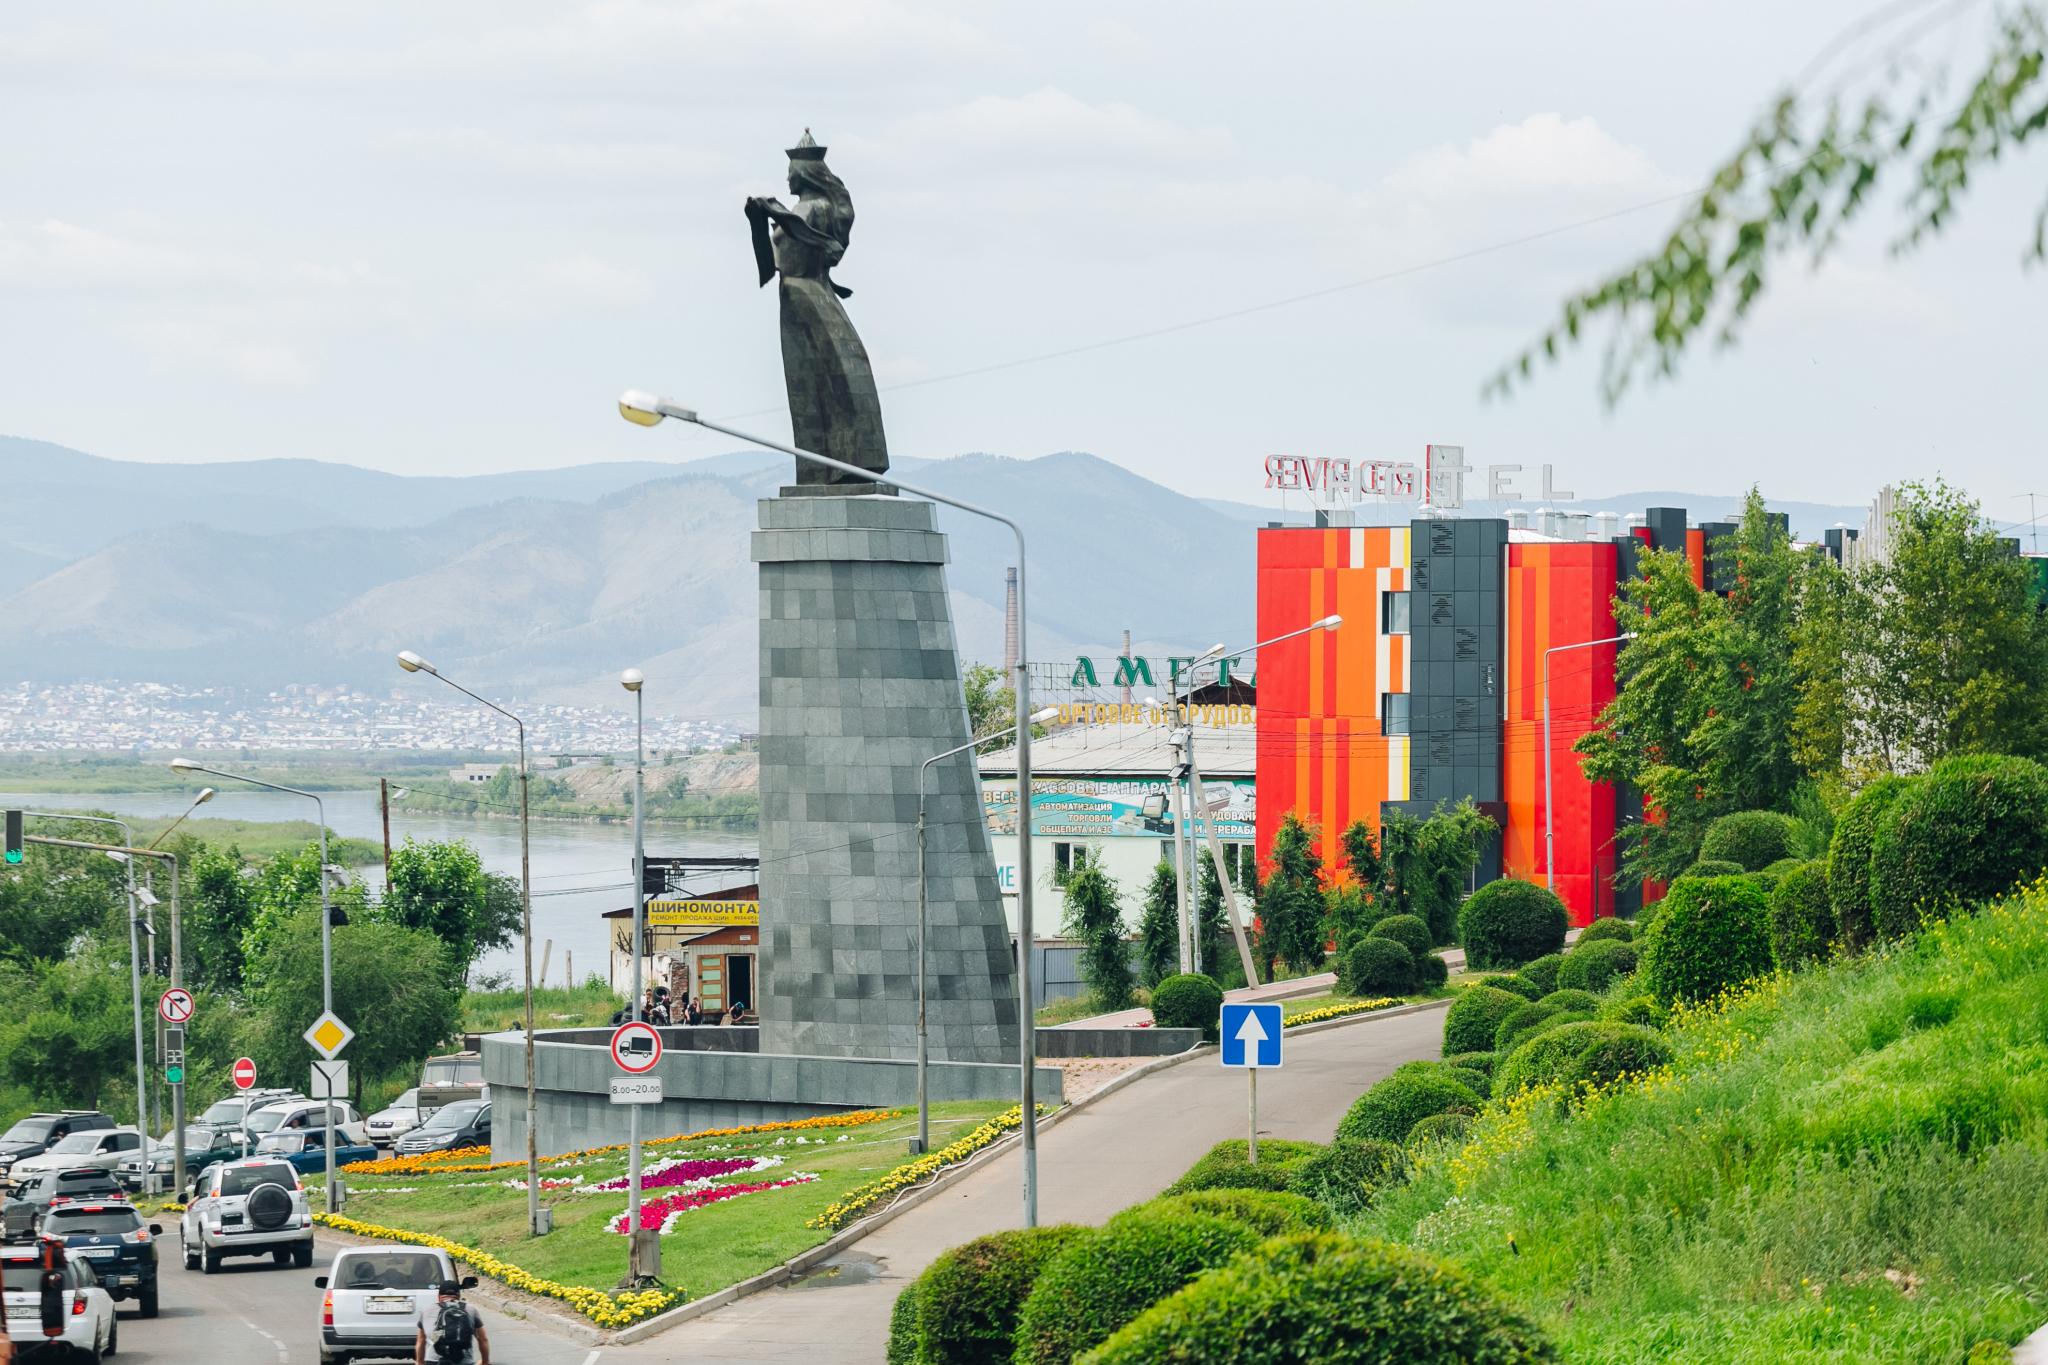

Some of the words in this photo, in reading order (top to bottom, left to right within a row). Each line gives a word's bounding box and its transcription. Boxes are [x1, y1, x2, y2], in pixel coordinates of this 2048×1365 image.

[1325, 464, 1574, 502] HOTEL
[1071, 656, 1257, 688] АМЕТ
[1048, 703, 1142, 724] ОРГОВОЕ
[1040, 802, 1113, 812] АВТОМАТИЗАЦИЯ
[1068, 814, 1113, 822] ТОРГОВЛИ
[1040, 825, 1087, 834] ОБЩЕПИТА
[1097, 825, 1113, 833] АЗС
[651, 902, 759, 914] ШИНОМОНТА
